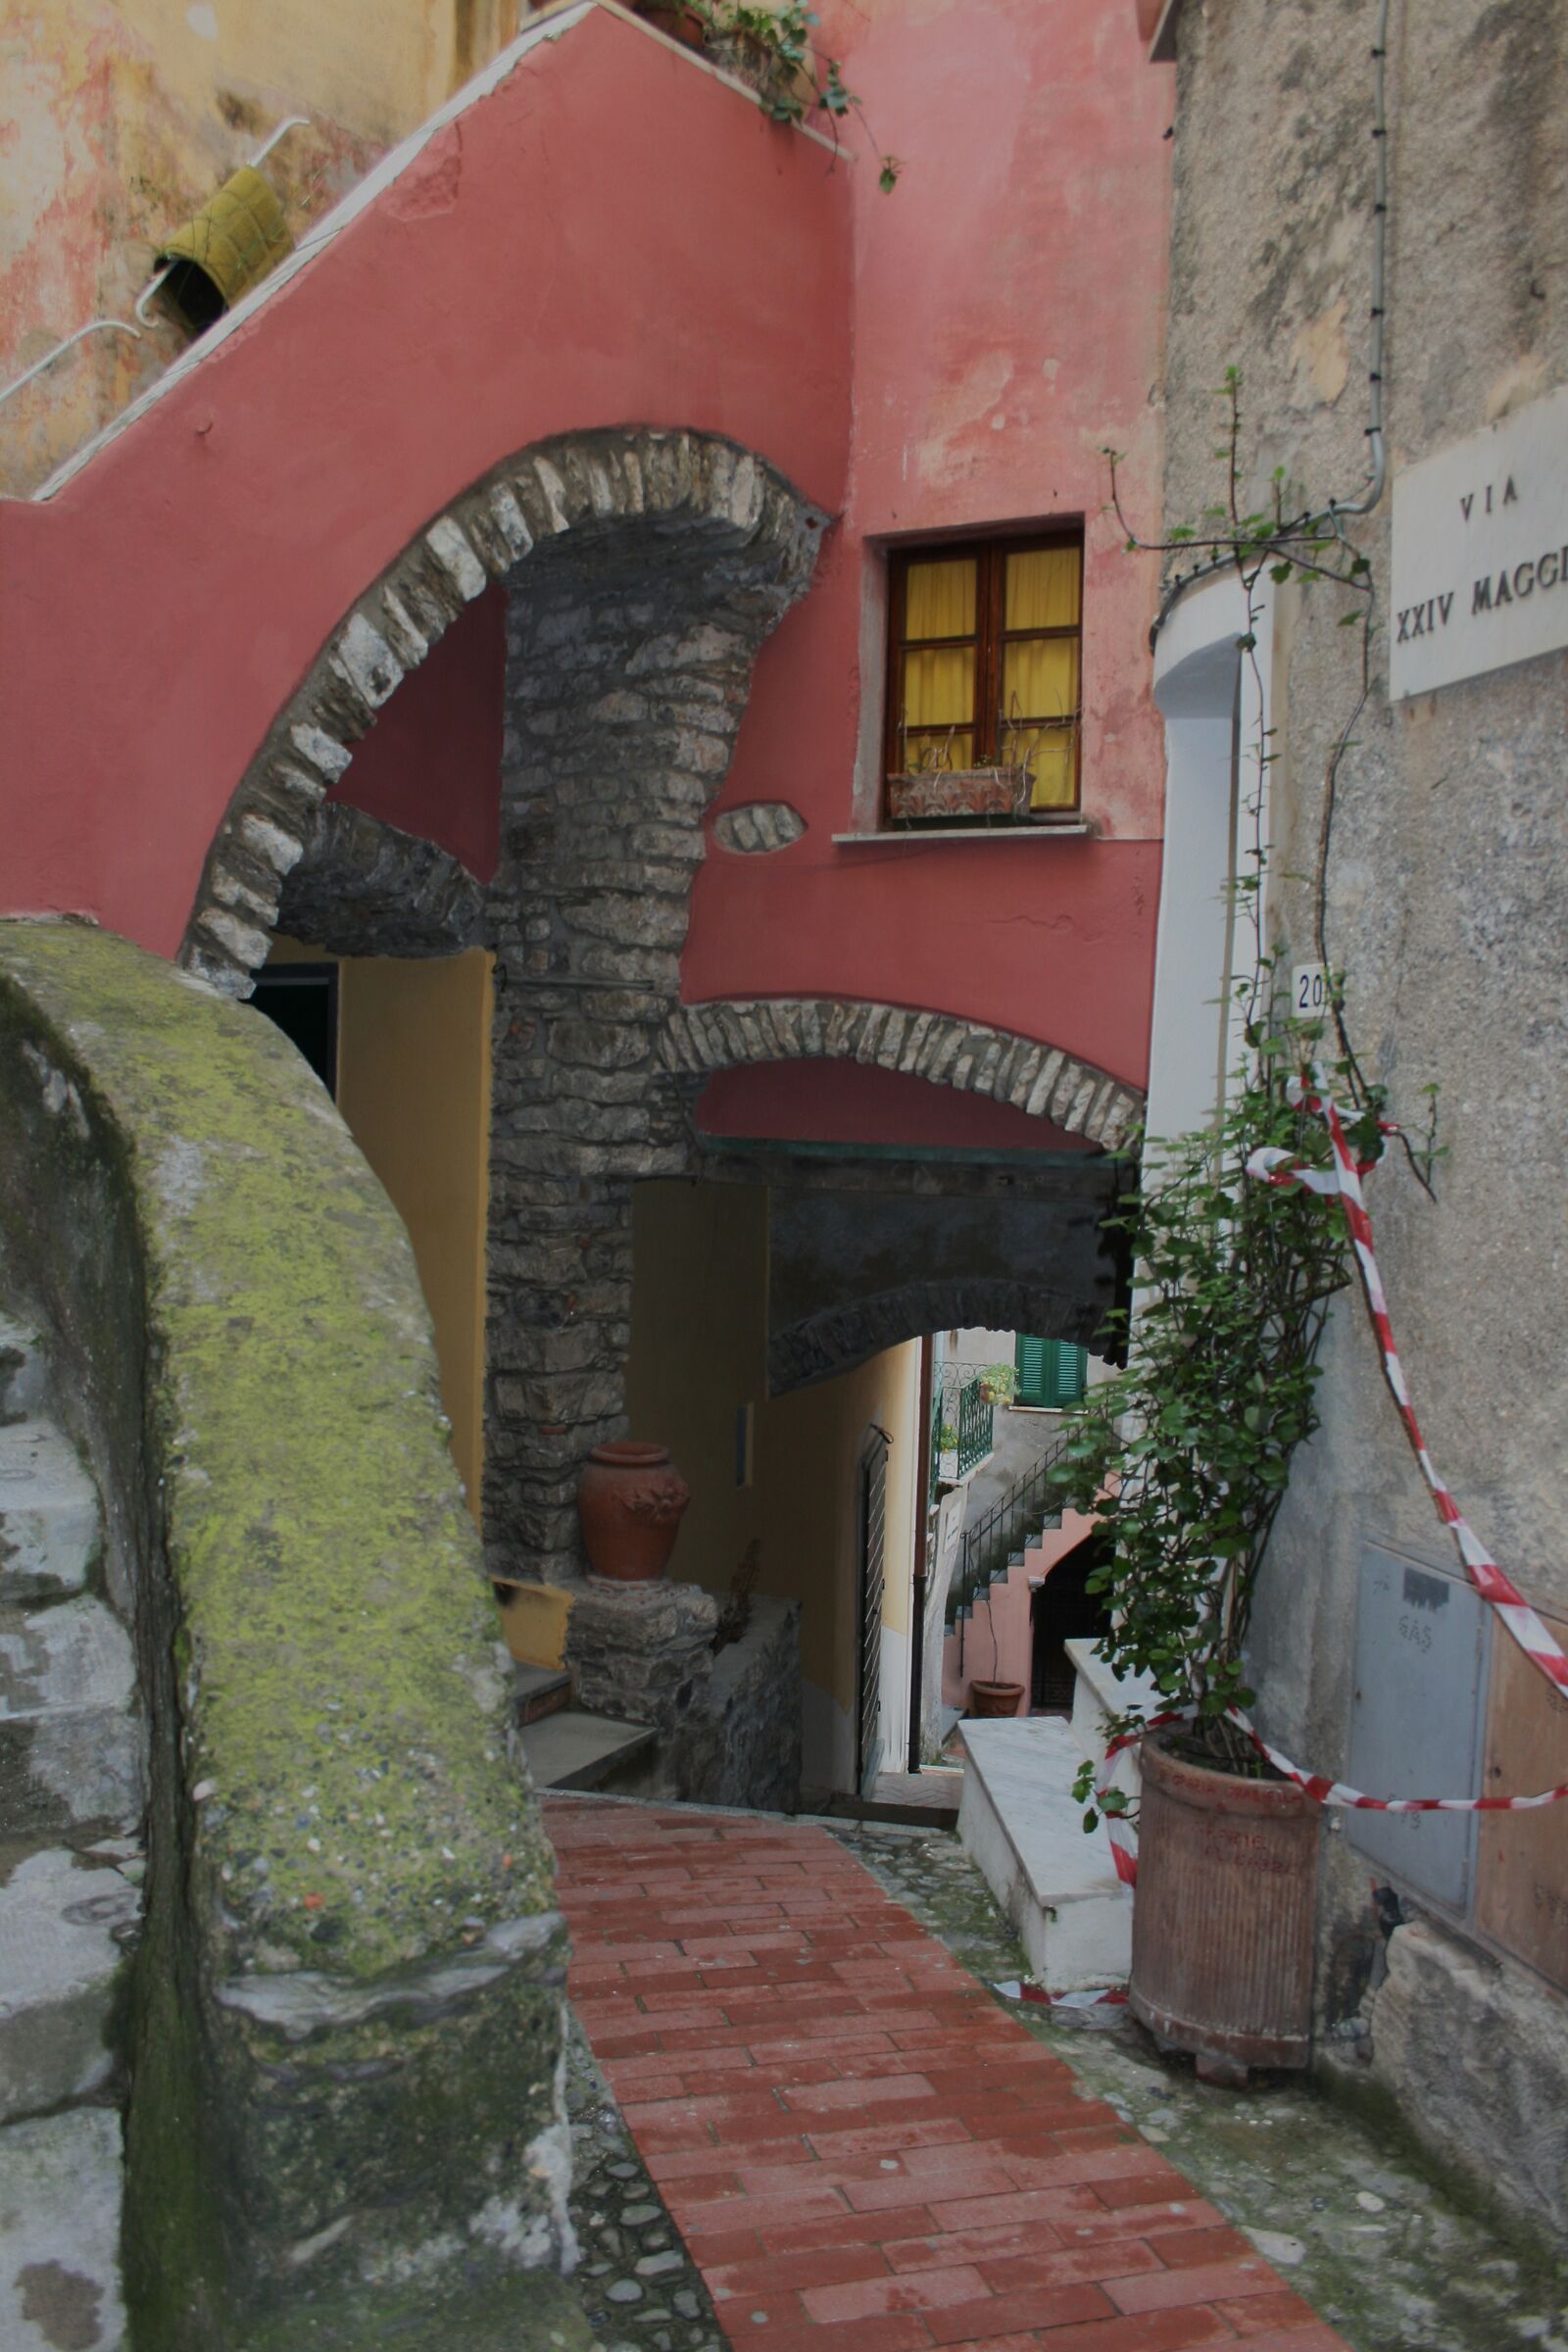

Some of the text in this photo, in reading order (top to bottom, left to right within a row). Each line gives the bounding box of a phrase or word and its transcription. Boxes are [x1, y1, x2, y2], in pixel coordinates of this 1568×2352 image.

[1460, 475, 1518, 521] VIA
[1396, 591, 1454, 643] XXIV
[1299, 974, 1322, 1007] 20
